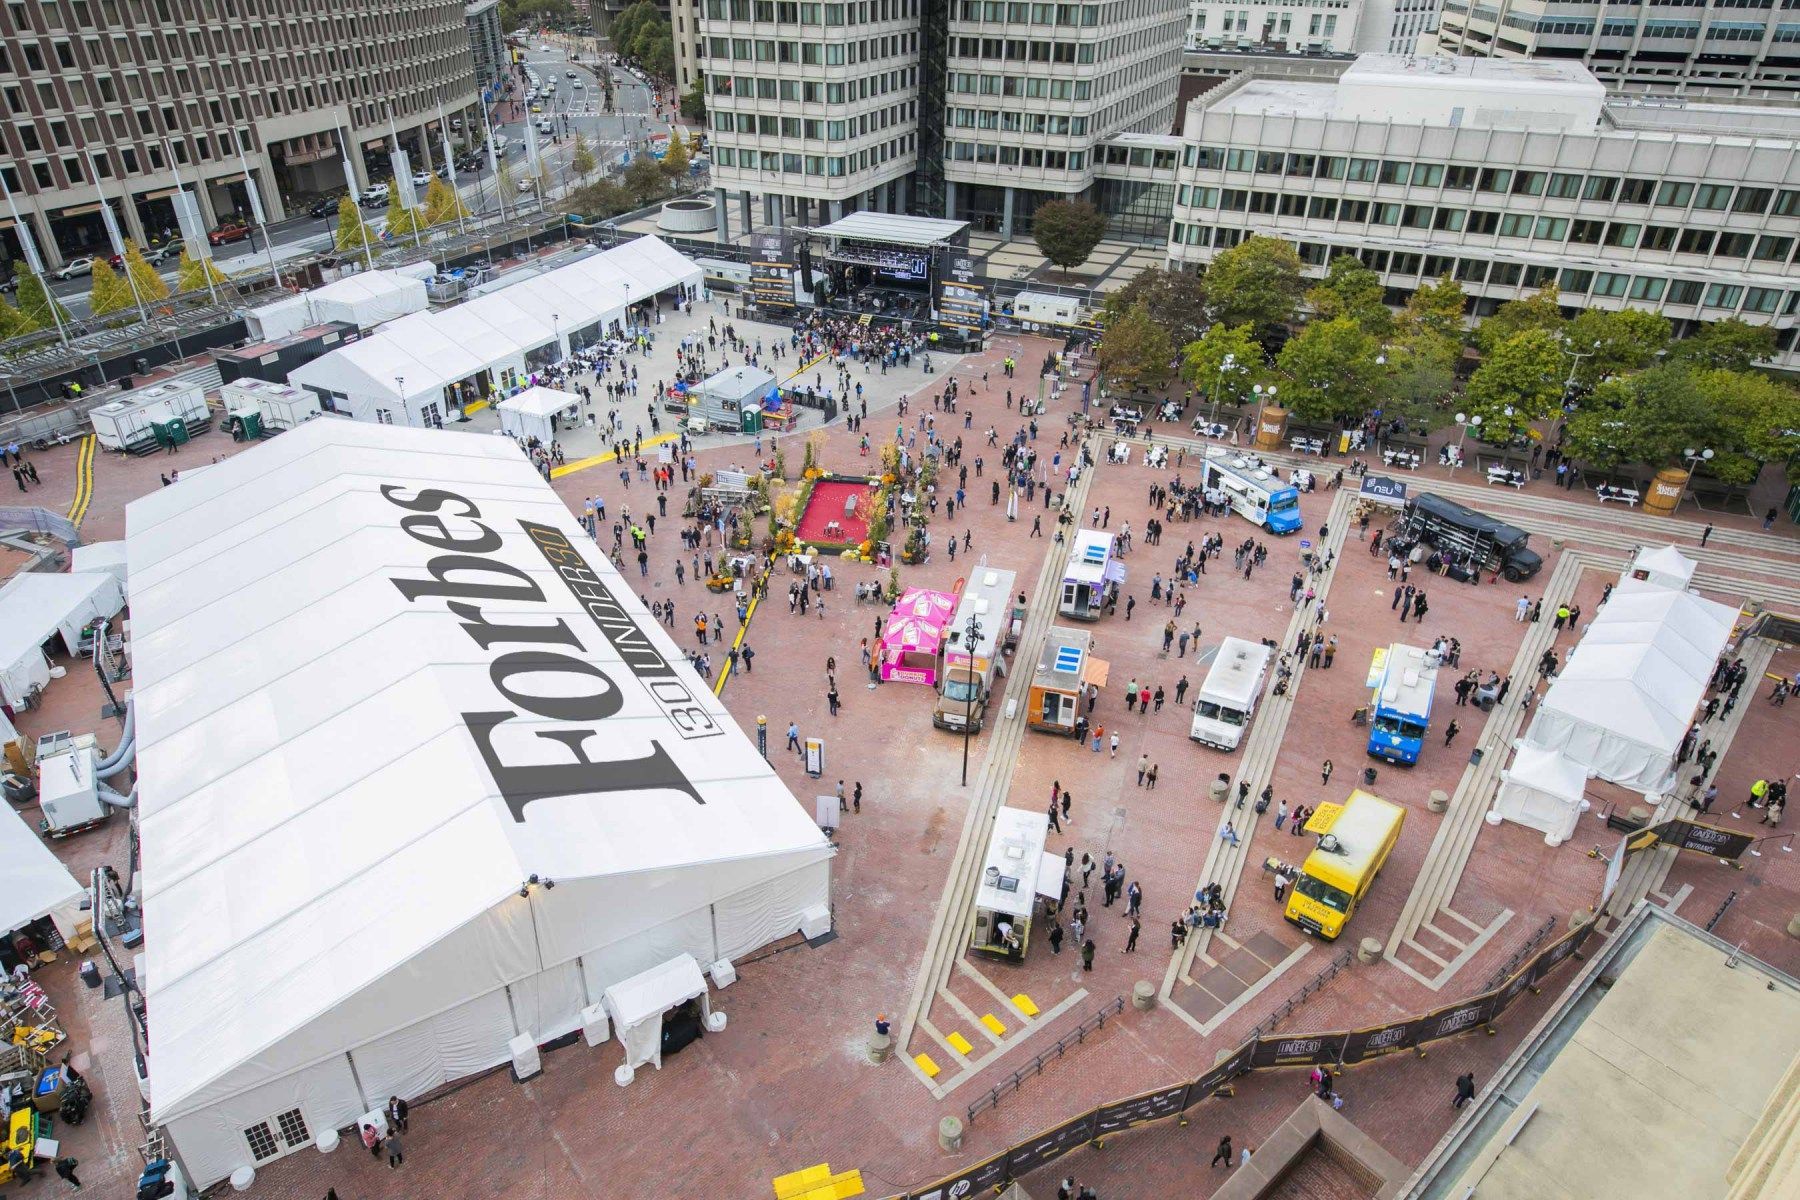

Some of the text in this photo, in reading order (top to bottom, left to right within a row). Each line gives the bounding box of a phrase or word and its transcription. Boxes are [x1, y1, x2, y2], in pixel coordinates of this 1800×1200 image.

[528, 527, 715, 732] 30 UNDER 30
[380, 484, 706, 823] Forbes
[1685, 841, 1717, 853] ENTRANCE
[1281, 1042, 1306, 1053] UNDER
[952, 1181, 968, 1196] hp
